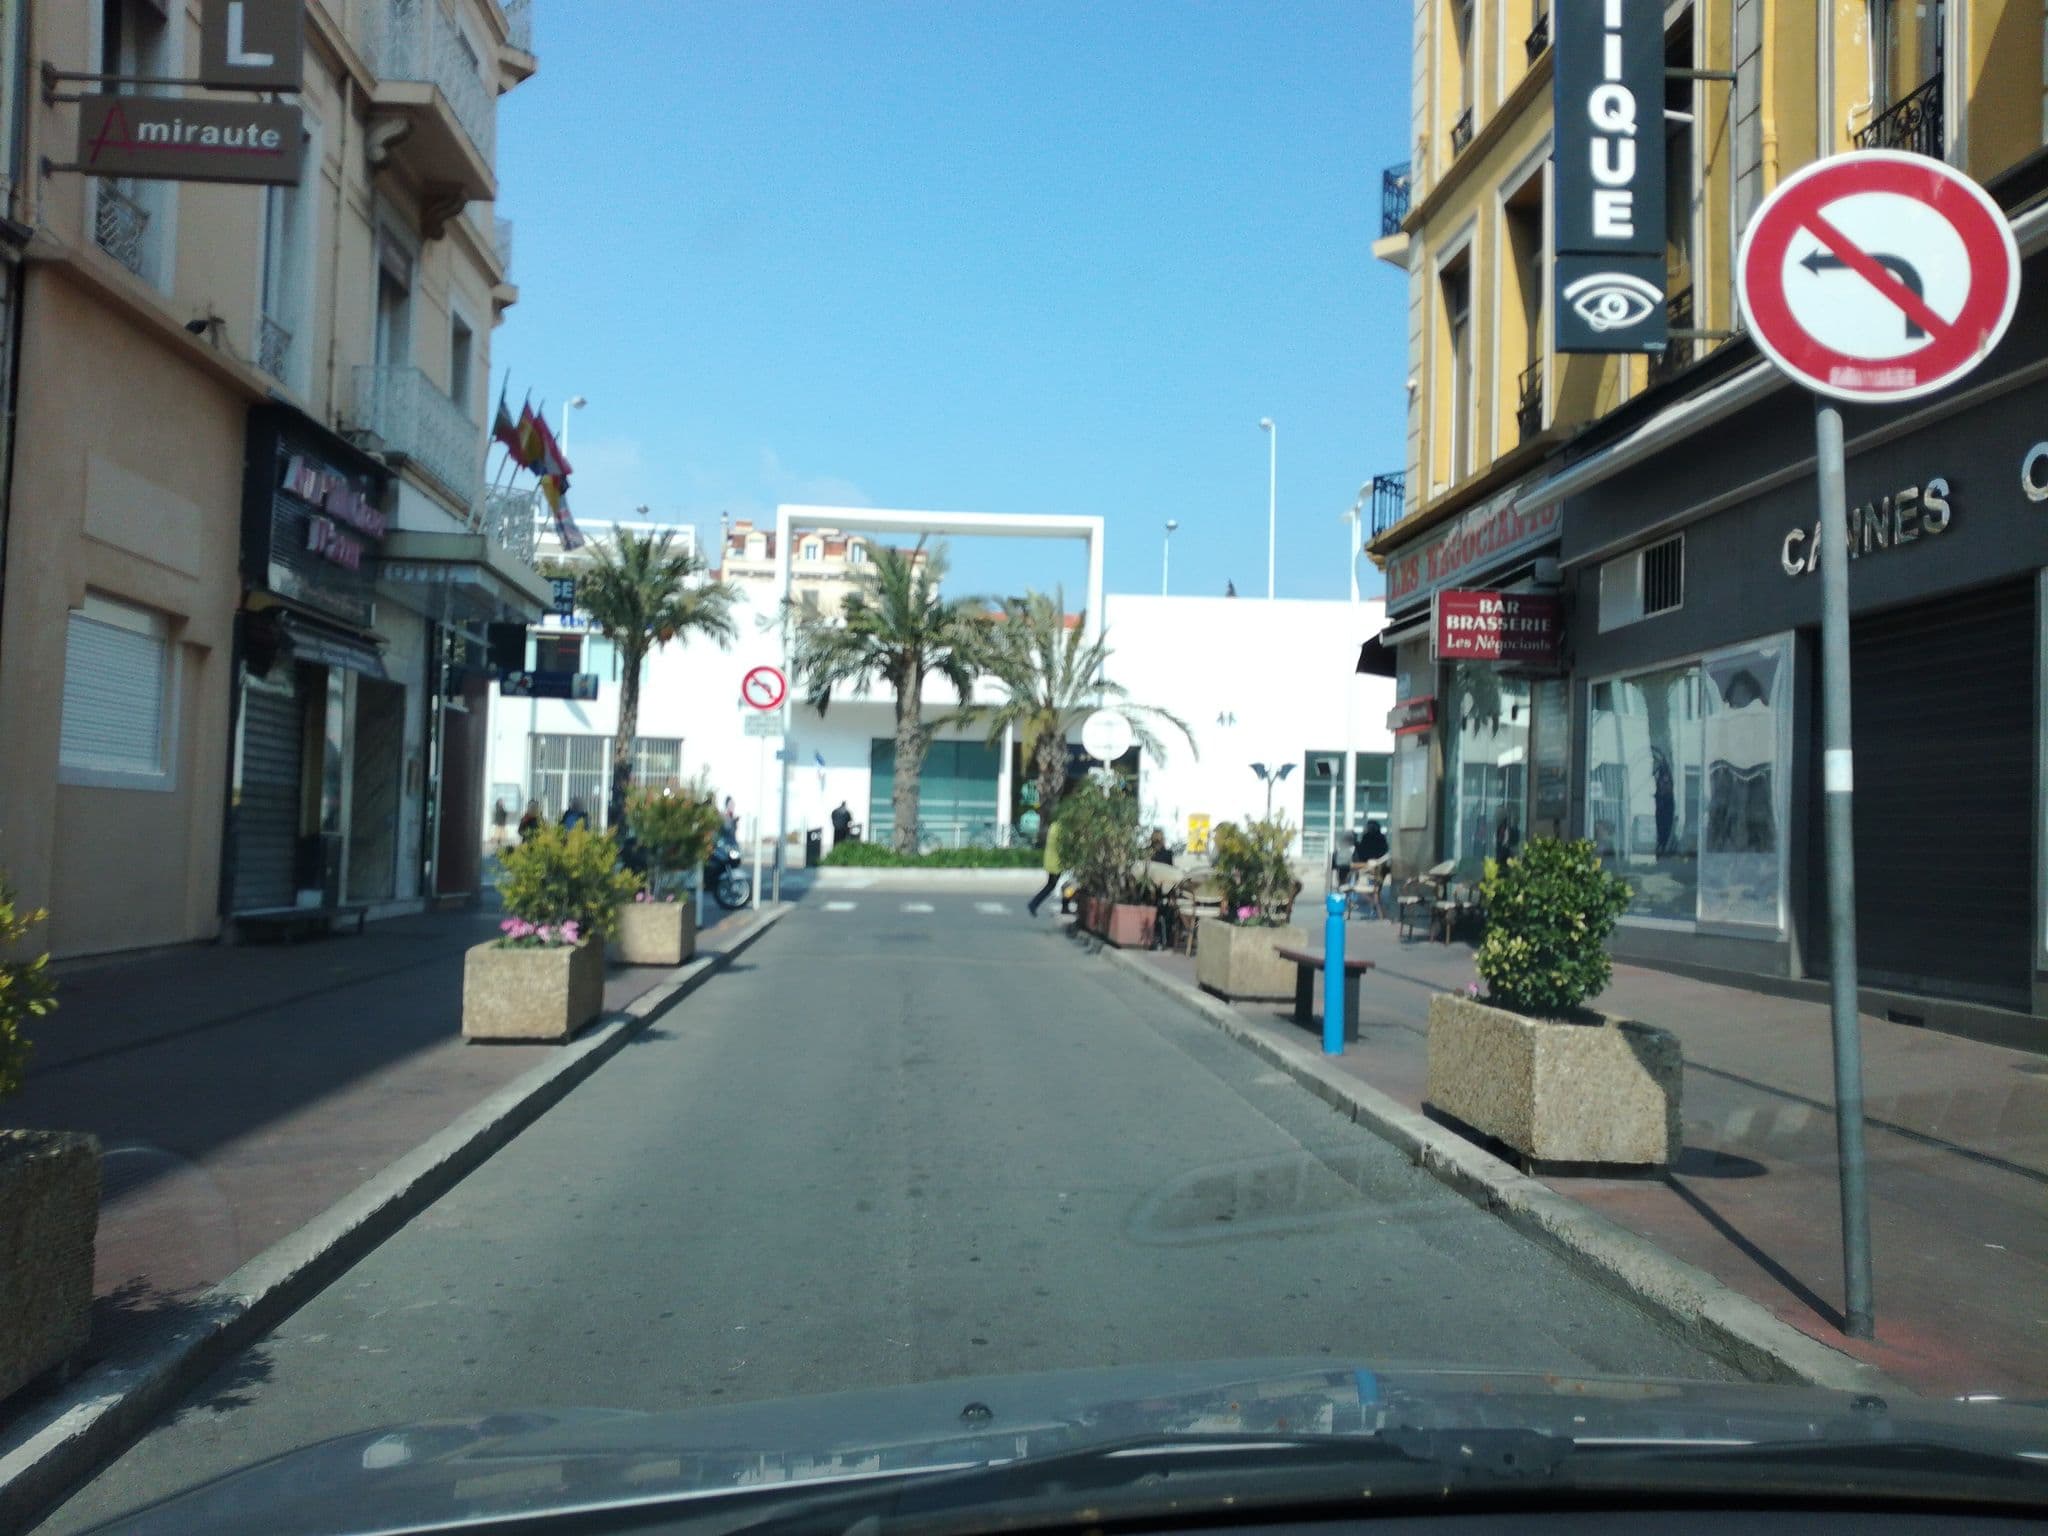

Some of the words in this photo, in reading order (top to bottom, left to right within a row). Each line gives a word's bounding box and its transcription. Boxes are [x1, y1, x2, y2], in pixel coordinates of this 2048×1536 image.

[226, 1, 275, 67] L
[88, 101, 282, 164] Amiraute
[1478, 599, 1521, 615] BAR
[1446, 615, 1552, 633] BRASSERIE
[1447, 633, 1472, 649] Les
[1474, 633, 1552, 654] Négociants
